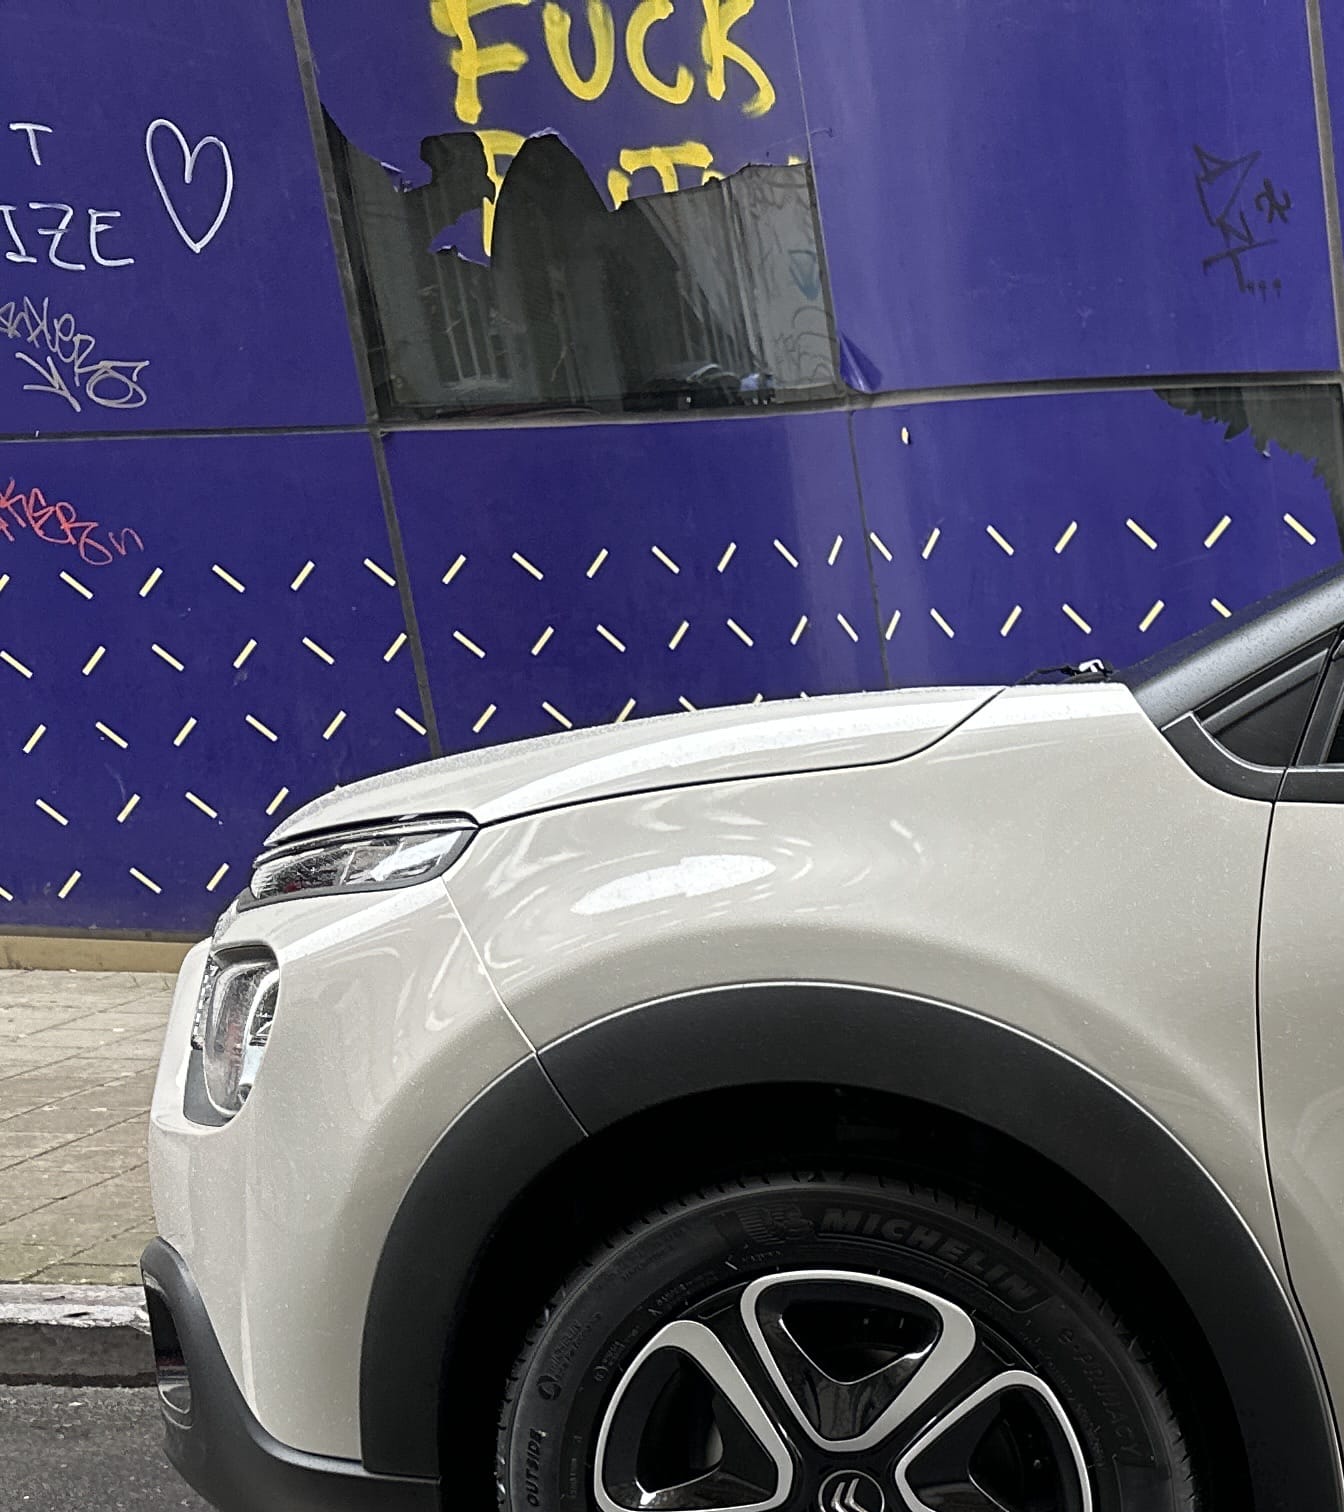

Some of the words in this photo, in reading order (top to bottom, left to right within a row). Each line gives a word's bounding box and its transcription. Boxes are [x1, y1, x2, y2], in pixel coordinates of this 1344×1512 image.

[431, 0, 776, 125] FUCK
[820, 1207, 1038, 1297] MICHELIN
[524, 1428, 546, 1507] OUTSIDE
